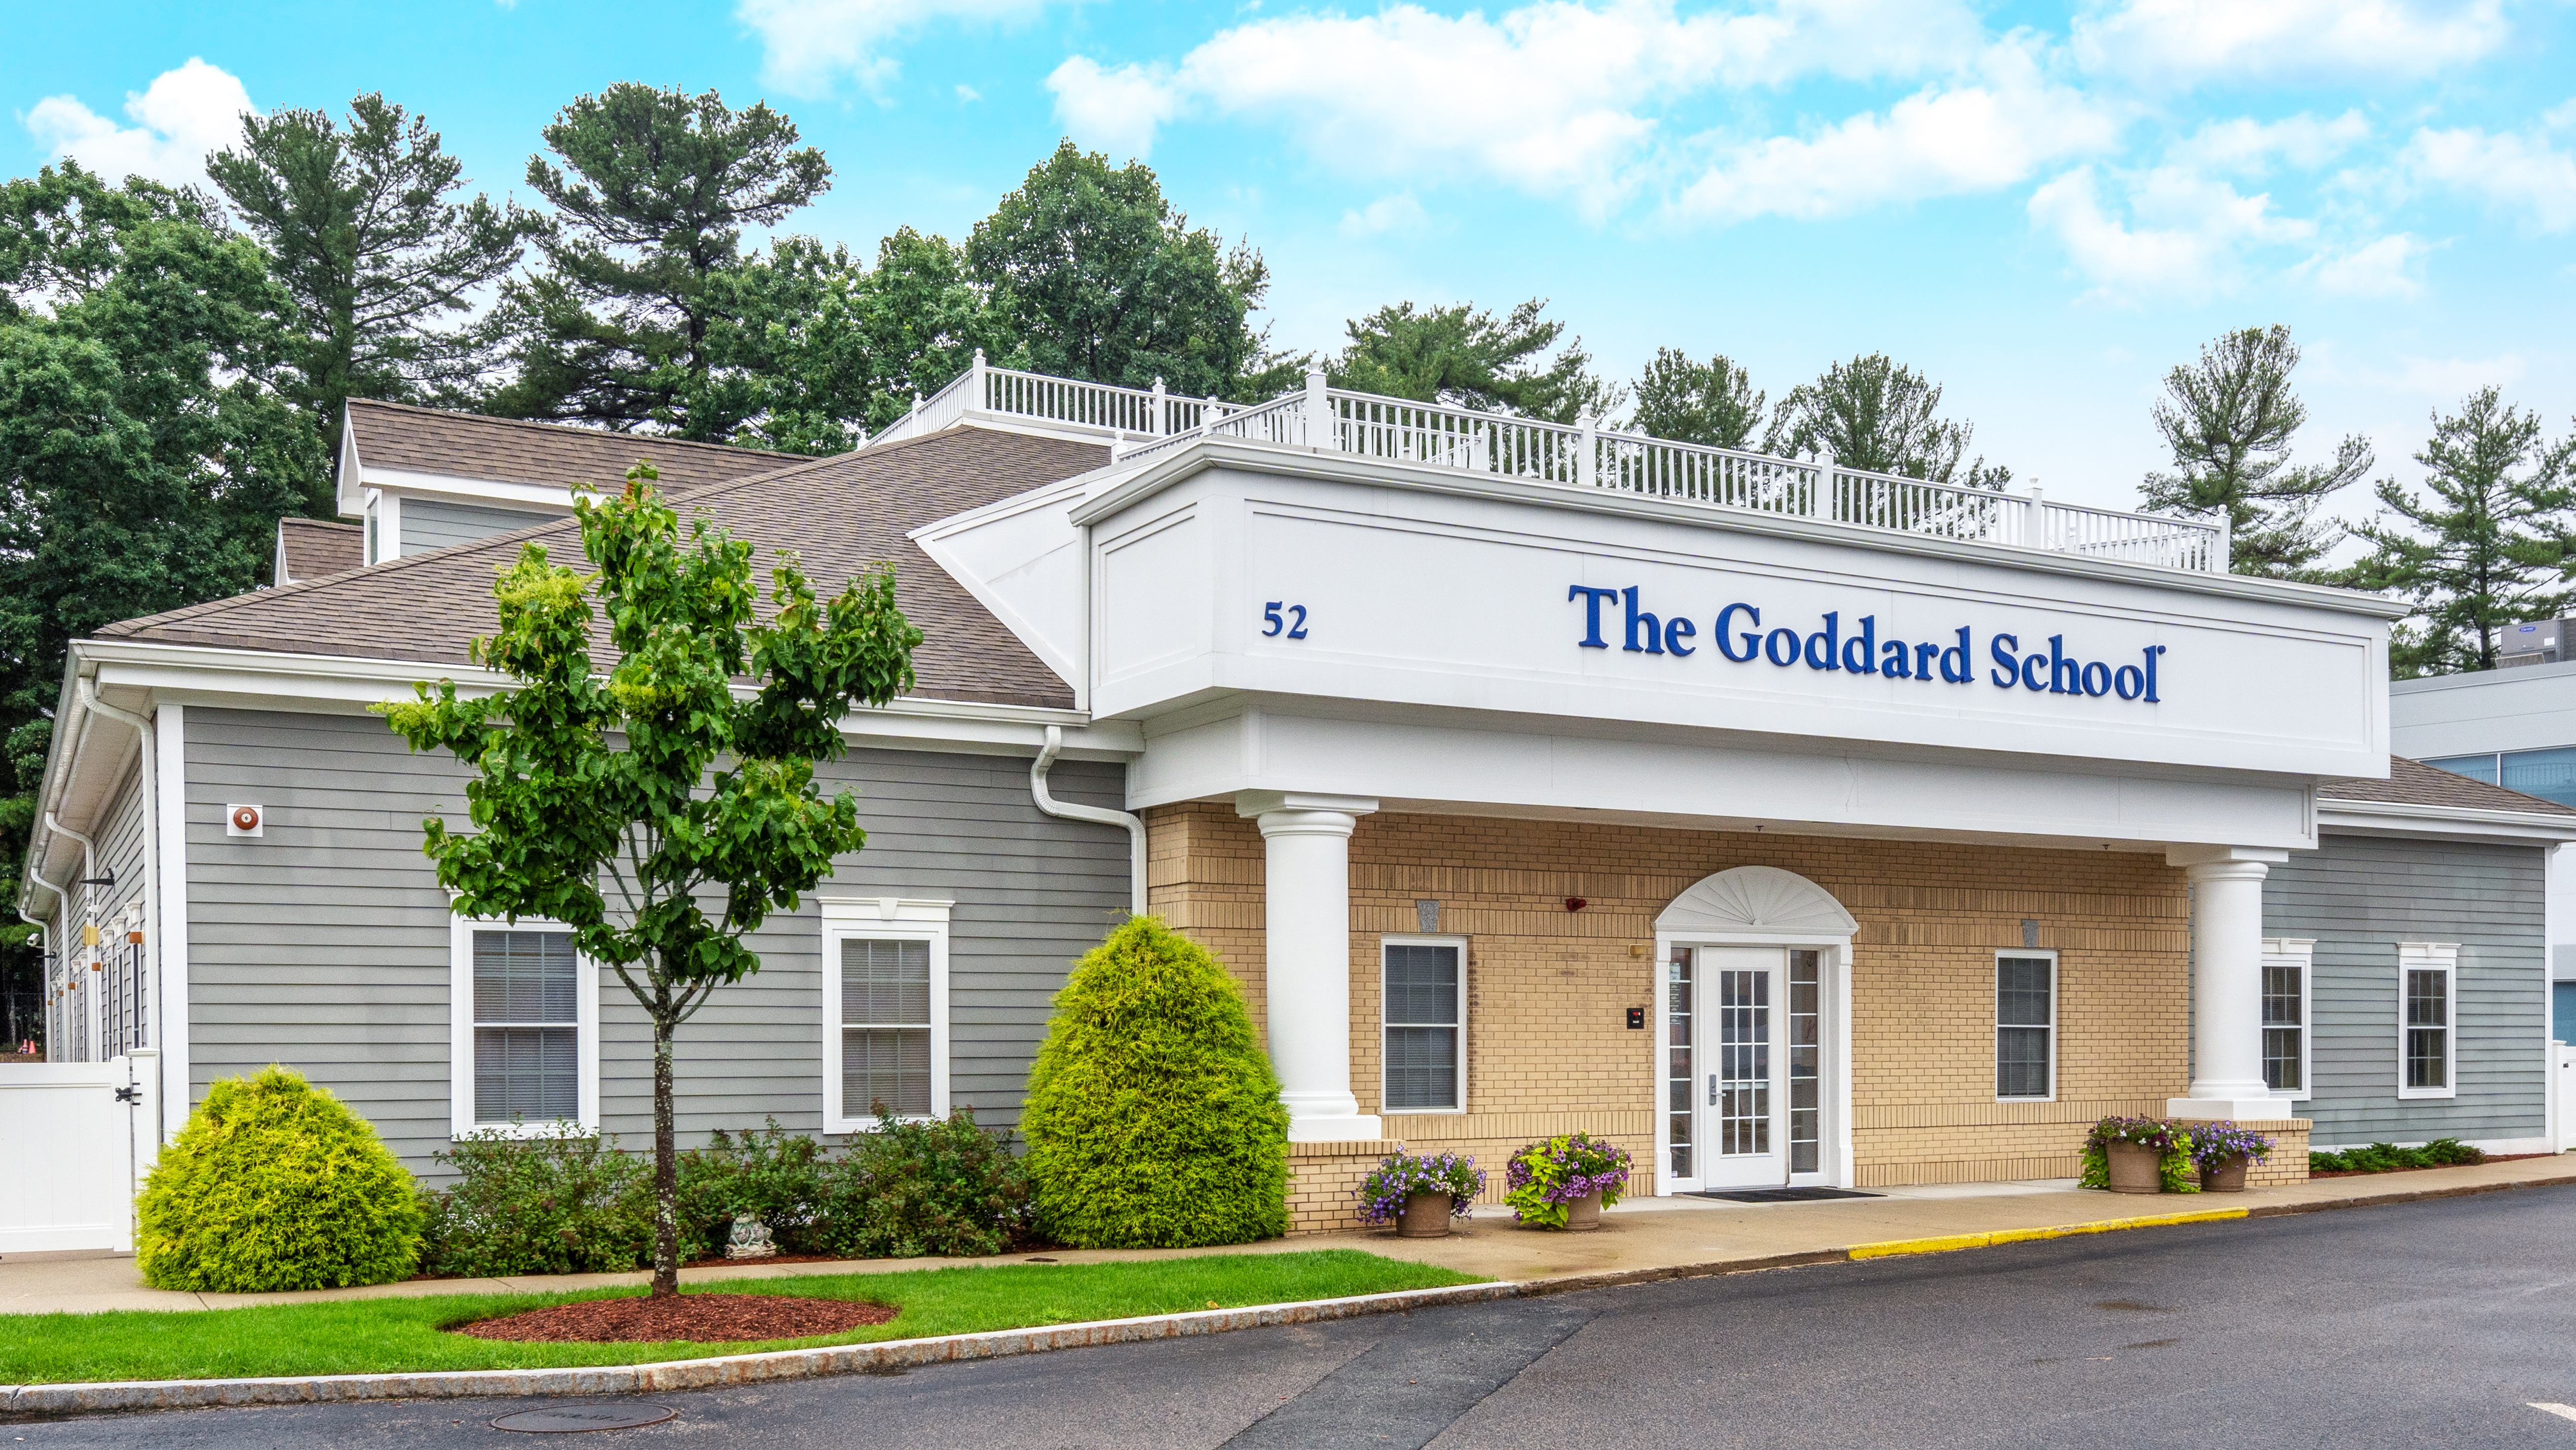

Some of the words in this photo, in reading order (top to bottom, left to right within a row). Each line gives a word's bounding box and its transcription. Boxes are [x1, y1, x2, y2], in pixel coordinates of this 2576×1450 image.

[1261, 600, 1309, 640] 52
[1568, 583, 1697, 657] The
[1714, 602, 1975, 684] Goddard
[1990, 632, 2161, 703] School
